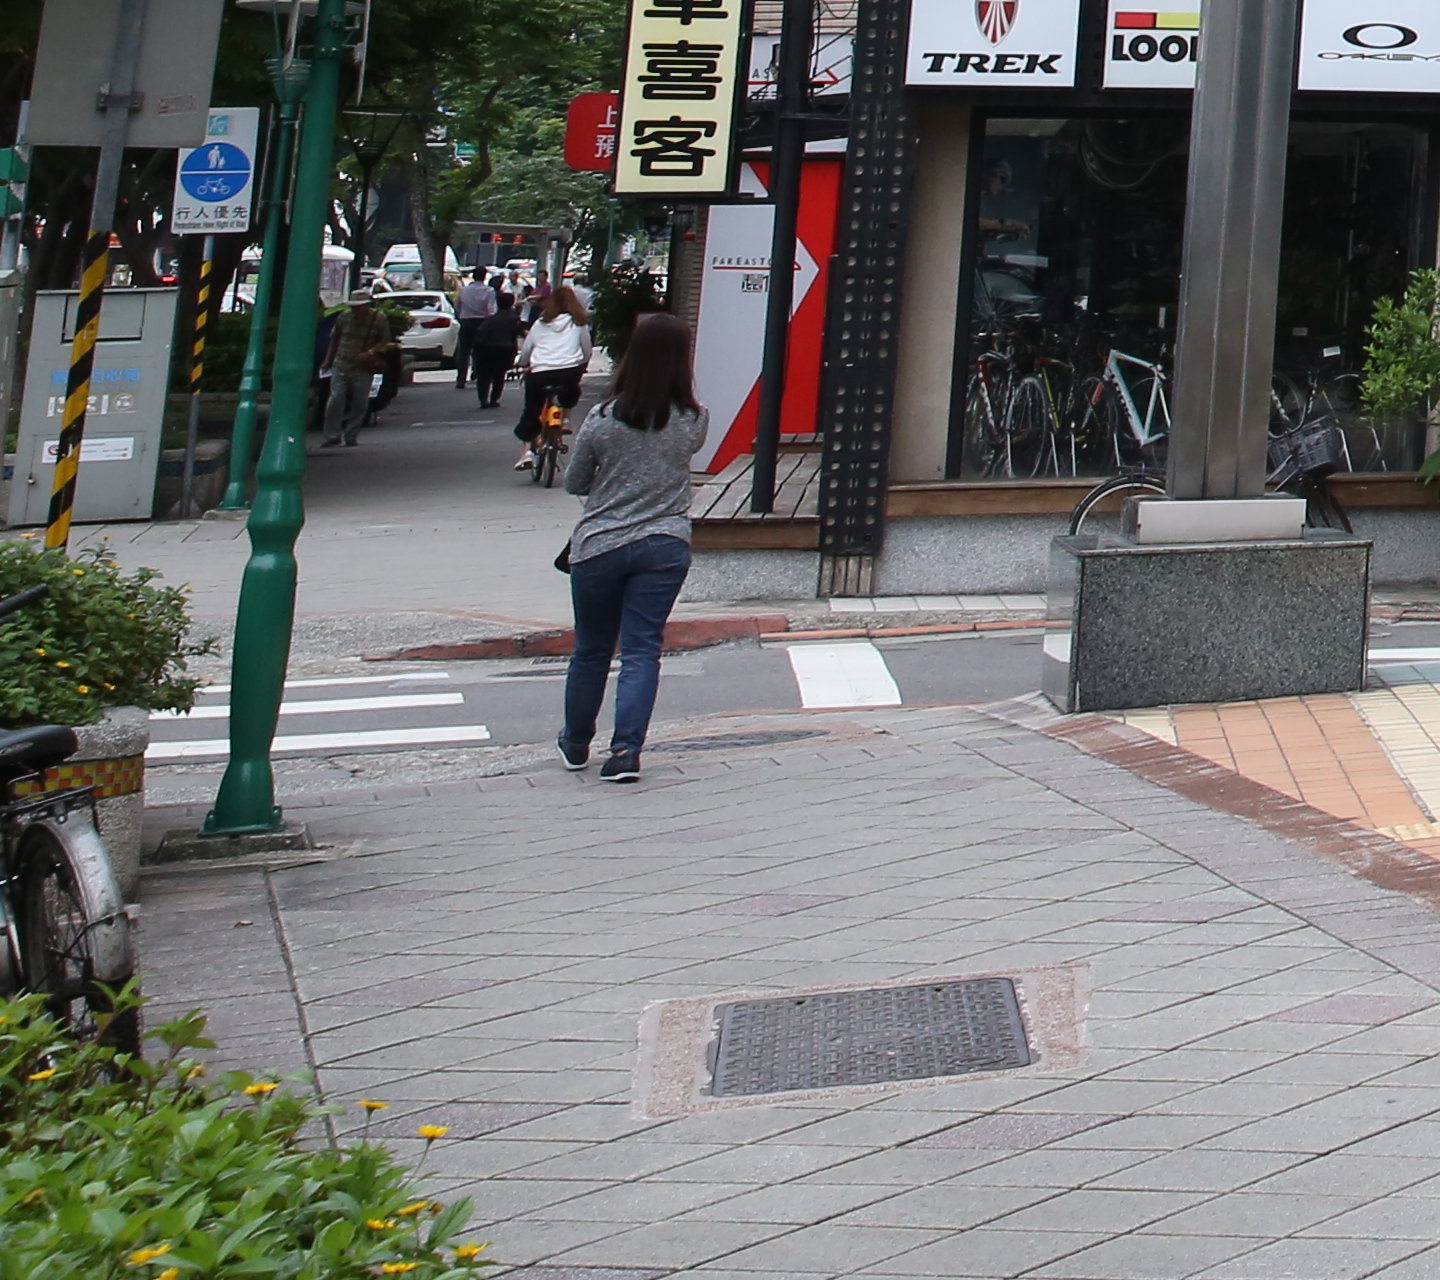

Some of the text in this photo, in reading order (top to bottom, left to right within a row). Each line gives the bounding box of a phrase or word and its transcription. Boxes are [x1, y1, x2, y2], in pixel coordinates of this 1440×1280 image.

[1112, 34, 1199, 64] LOO
[921, 53, 1062, 75] TREK
[175, 205, 248, 220] 行人優先
